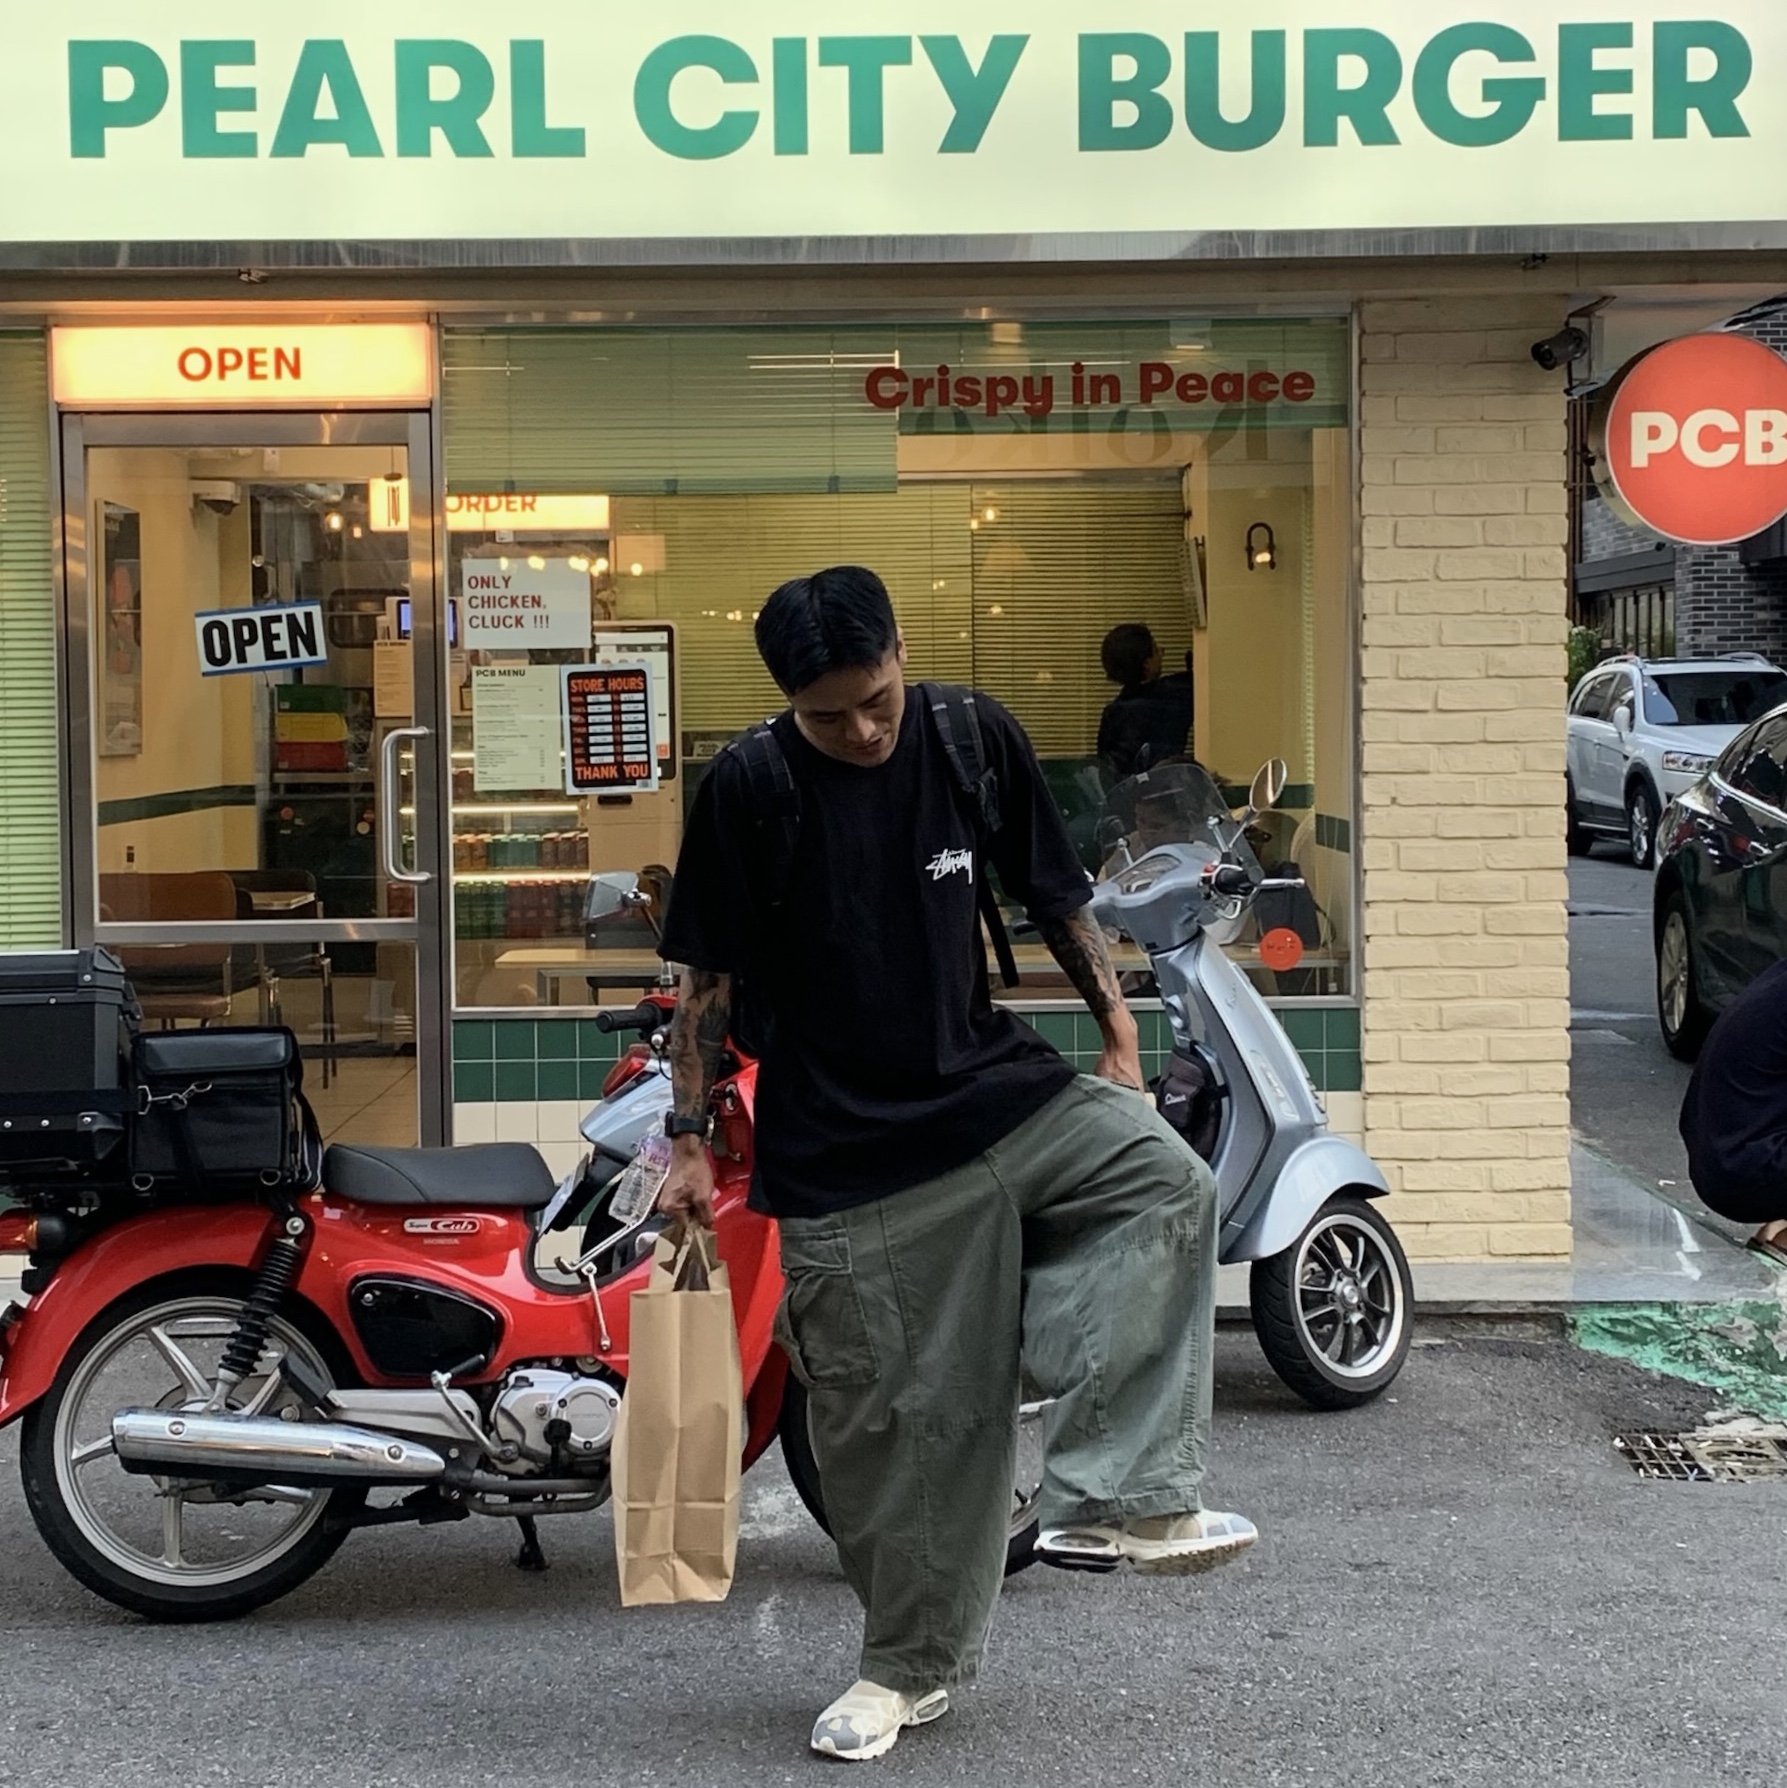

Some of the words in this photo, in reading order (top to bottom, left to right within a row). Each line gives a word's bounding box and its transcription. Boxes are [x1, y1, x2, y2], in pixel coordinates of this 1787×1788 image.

[67, 39, 587, 158] PEARL
[633, 34, 1031, 160] CITY
[1077, 20, 1752, 153] BURGER
[178, 347, 301, 382] OPEN
[865, 364, 1053, 417] Crispy
[1071, 361, 1121, 404] in
[1139, 362, 1315, 404] Peace
[1631, 408, 1787, 468] PCB
[445, 492, 537, 513] ORDER
[468, 575, 511, 589] ONLY
[468, 595, 546, 609] CHICKEN,
[469, 615, 524, 628] CLUCK
[534, 615, 549, 628] !!!
[202, 610, 320, 668] OPEN
[571, 679, 605, 693] STORE
[608, 676, 645, 690] HOURS
[575, 766, 618, 780] THANK
[623, 764, 648, 777] YOU
